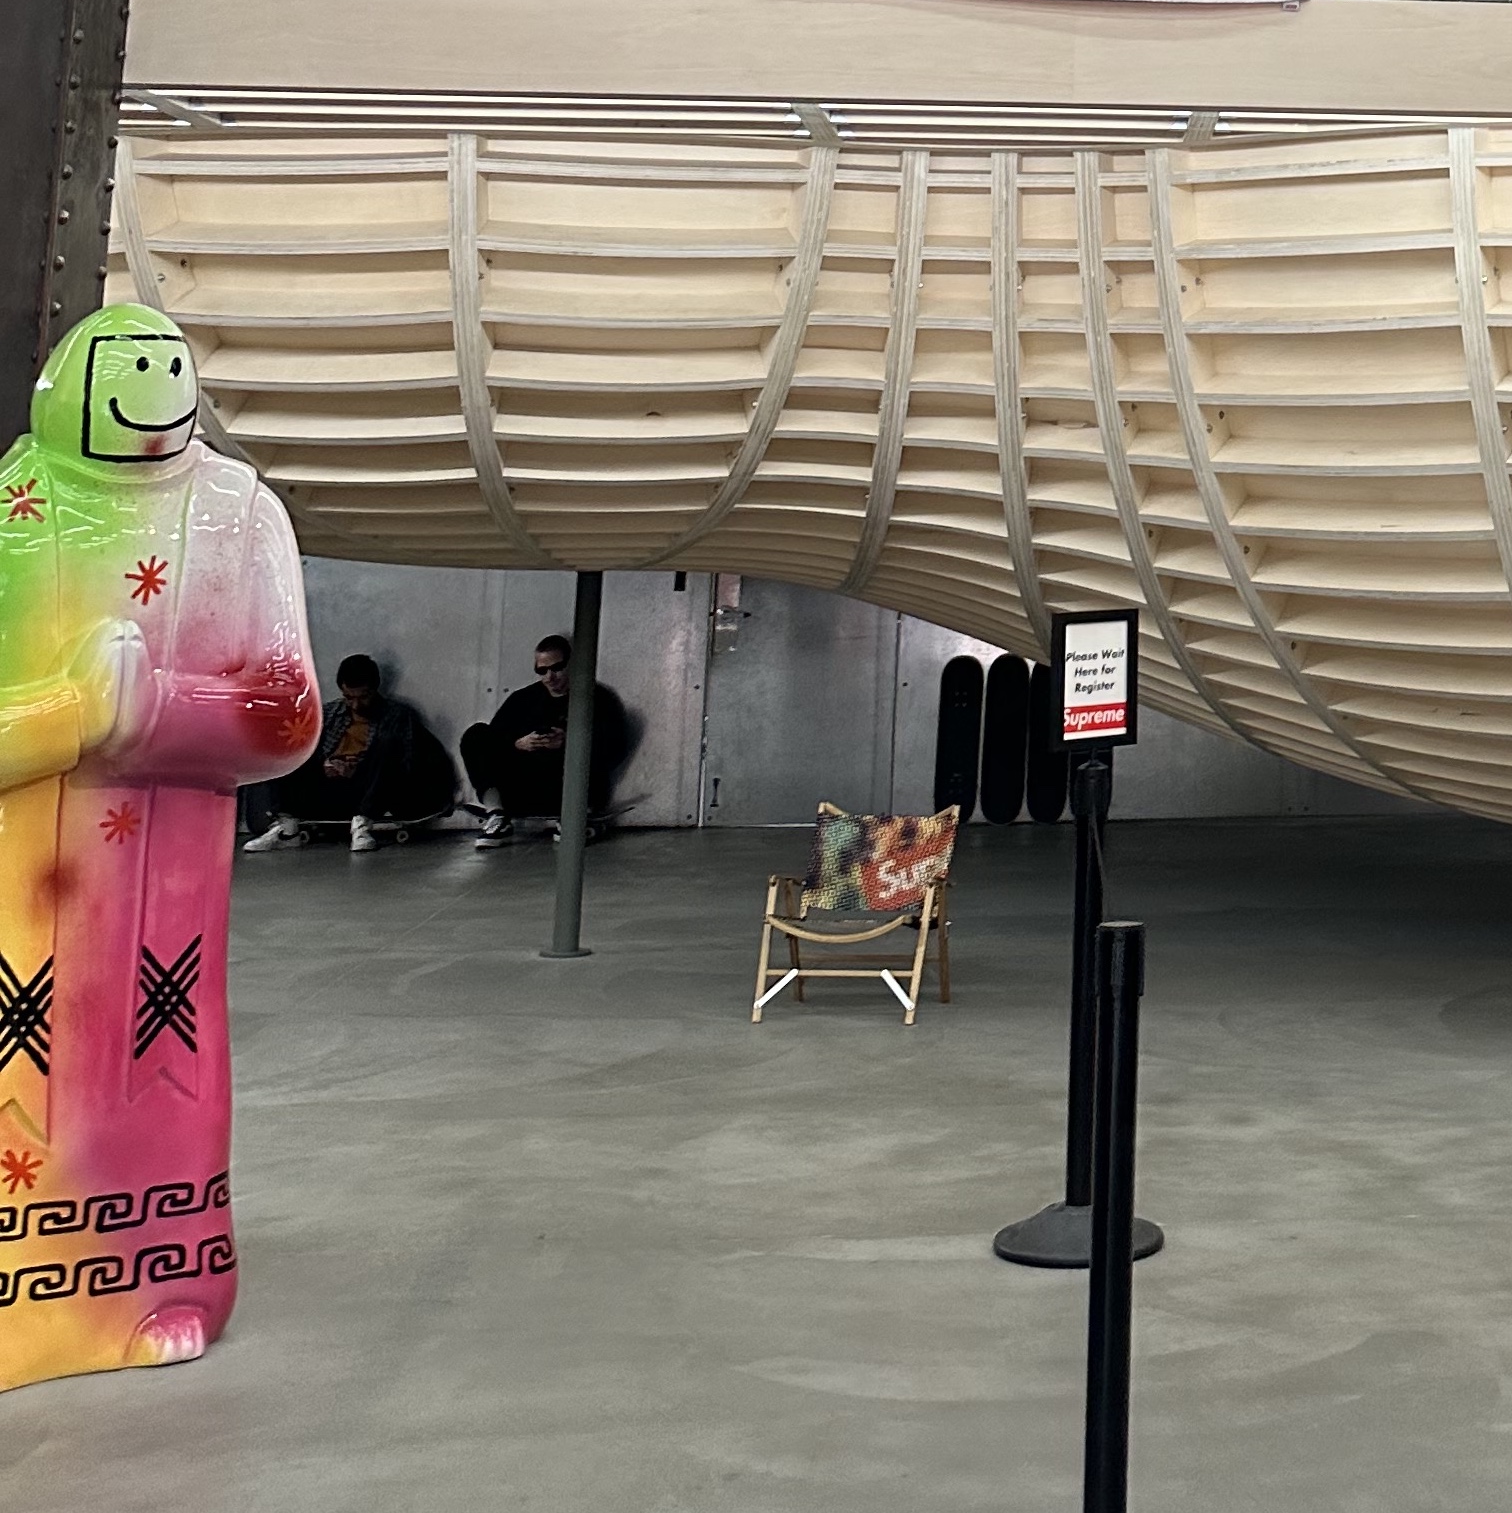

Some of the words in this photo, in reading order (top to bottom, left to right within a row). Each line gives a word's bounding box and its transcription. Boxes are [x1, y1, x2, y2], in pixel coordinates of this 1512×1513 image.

[1065, 651, 1098, 662] Please
[1101, 648, 1125, 659] Wait
[1074, 667, 1098, 677] Here
[1101, 664, 1116, 675] for
[1074, 680, 1115, 694] Register
[1064, 708, 1125, 730] Supreme
